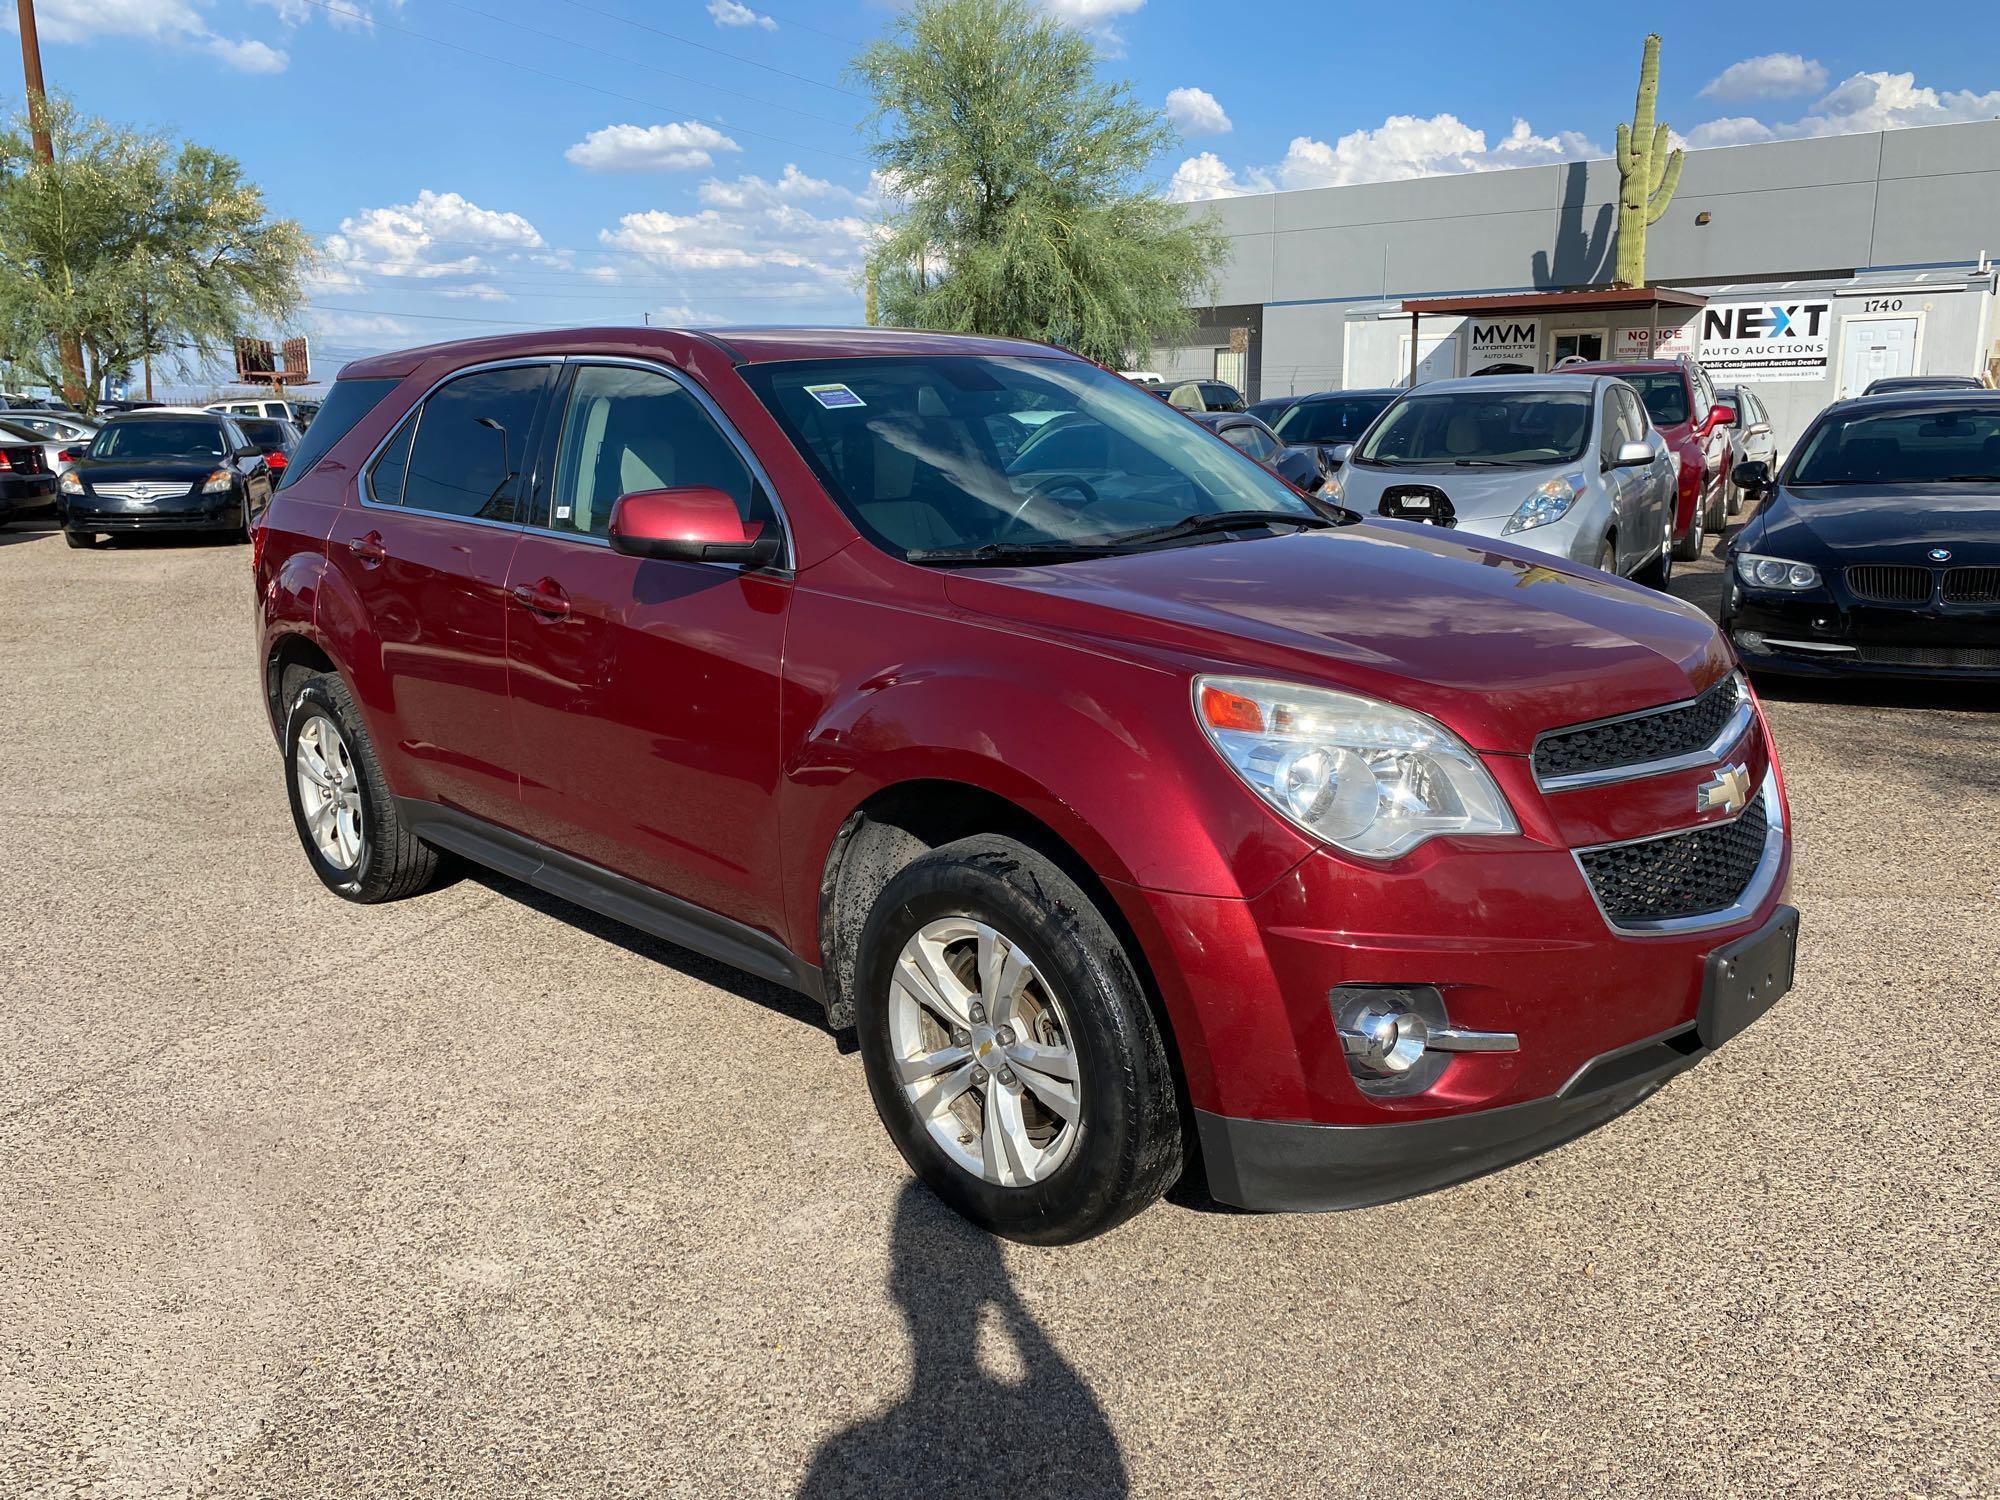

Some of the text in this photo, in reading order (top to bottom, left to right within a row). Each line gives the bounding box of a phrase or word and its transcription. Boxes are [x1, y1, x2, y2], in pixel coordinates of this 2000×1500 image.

[1863, 299, 1903, 313] 1740
[1703, 304, 1828, 341] NEXT
[1473, 323, 1535, 344] MVM
[1628, 329, 1682, 340] NOICE
[1471, 343, 1536, 351] AUTOMOTIVE
[1702, 343, 1824, 356] AUTO AUCTIONS
[1723, 360, 1768, 369] Consignment
[1797, 358, 1822, 366] Dealer
